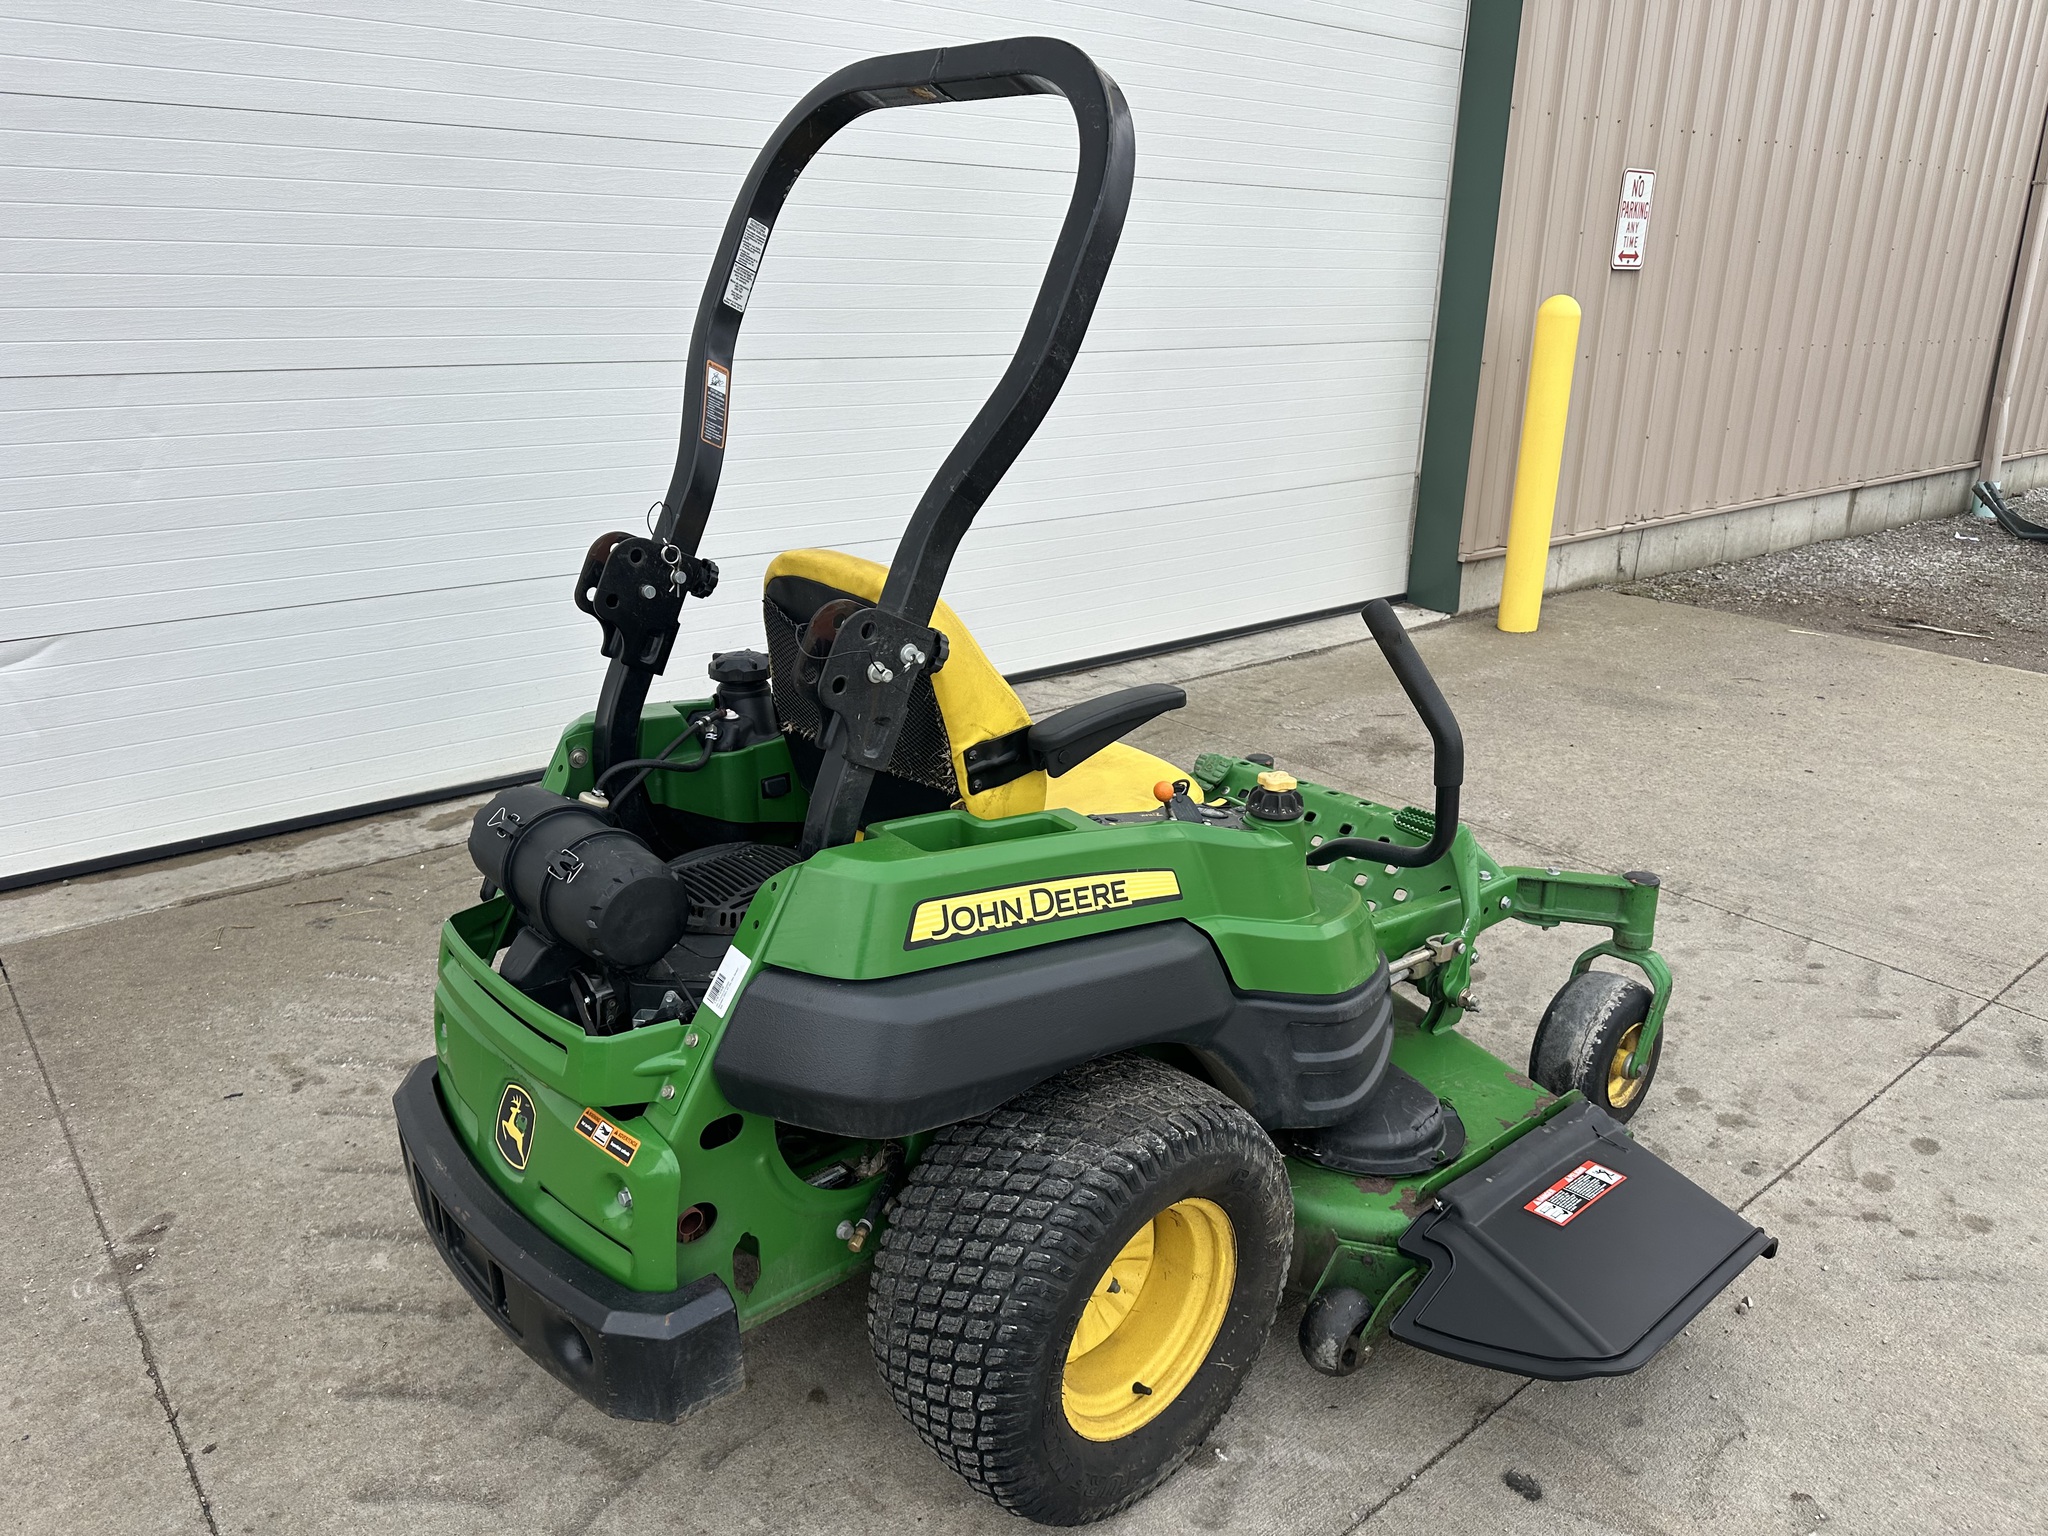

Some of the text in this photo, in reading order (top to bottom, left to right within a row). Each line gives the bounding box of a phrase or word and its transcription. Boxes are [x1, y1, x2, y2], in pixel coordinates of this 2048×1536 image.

[1632, 179, 1645, 198] NO
[1620, 201, 1649, 220] PARKING
[1626, 222, 1640, 233] ANY
[1623, 236, 1639, 248] TIME
[931, 880, 1129, 937] JOHN DEERE
